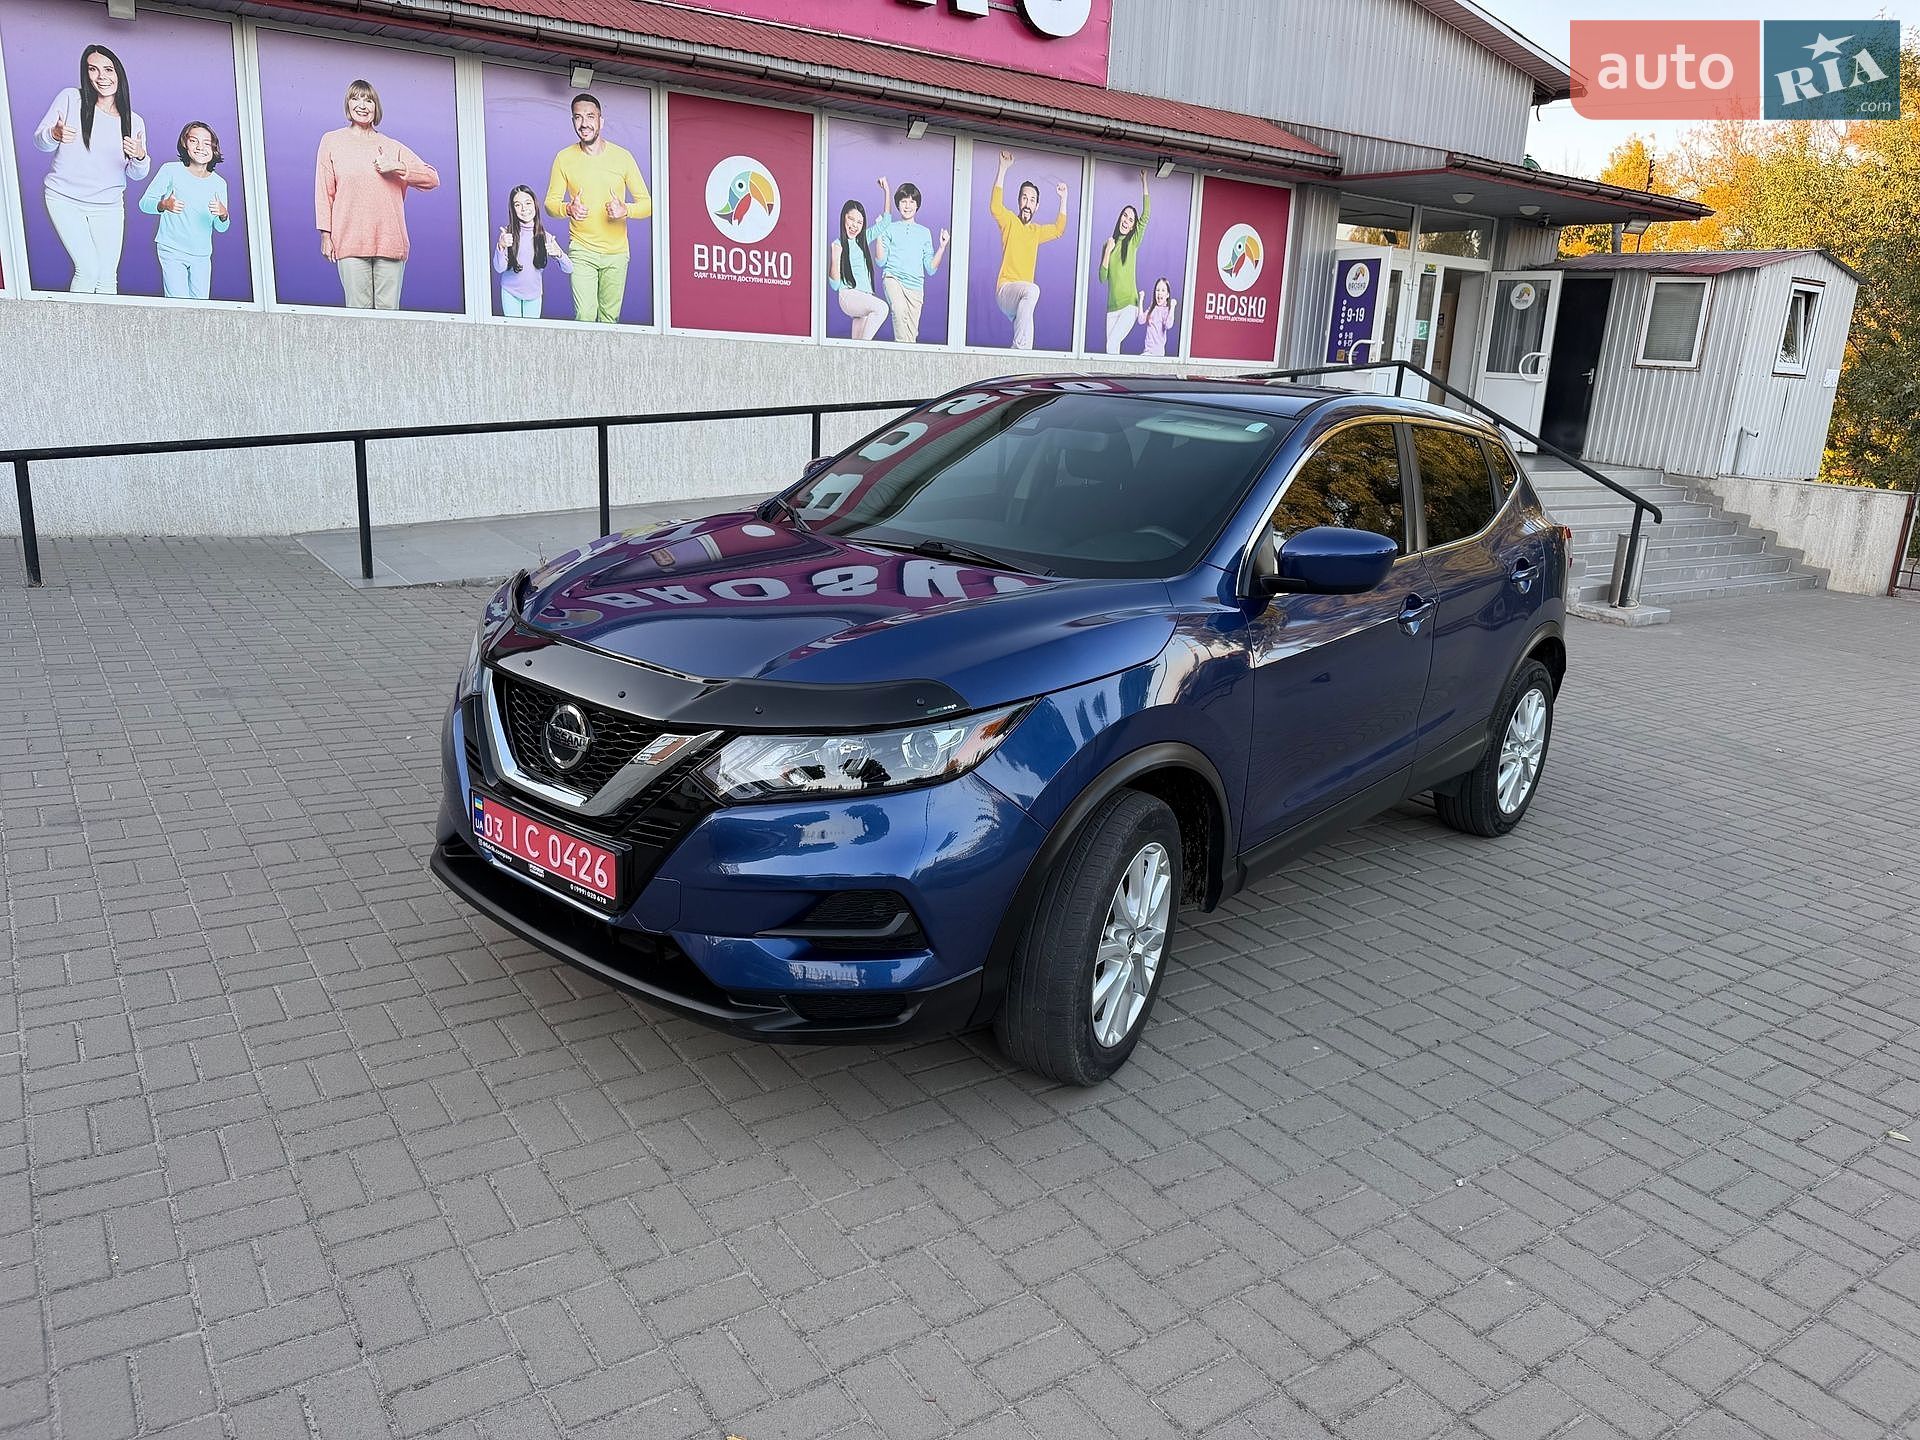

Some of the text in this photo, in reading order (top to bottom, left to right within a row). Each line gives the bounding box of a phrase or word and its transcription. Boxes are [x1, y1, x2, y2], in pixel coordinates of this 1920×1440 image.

[693, 244, 792, 279] BROSKO
[1205, 293, 1266, 318] BROSKO
[1346, 308, 1365, 322] 9-19
[475, 818, 483, 831] UA
[484, 814, 503, 842] 03
[548, 834, 608, 888] 0426
